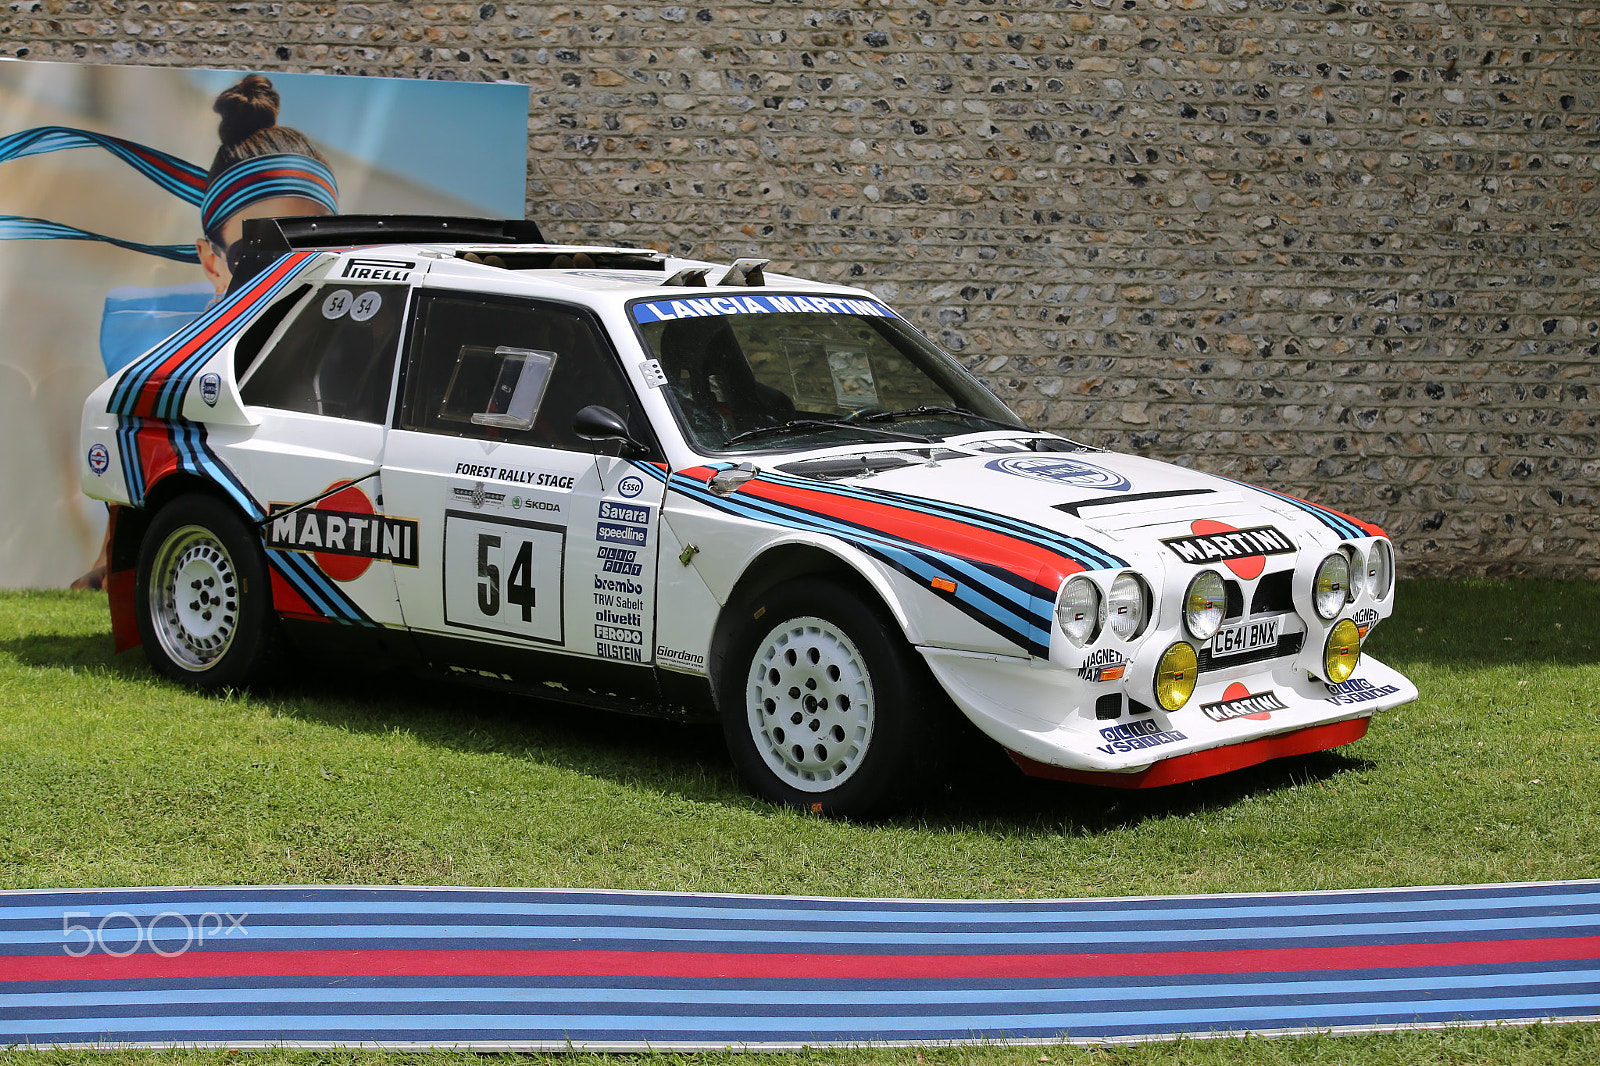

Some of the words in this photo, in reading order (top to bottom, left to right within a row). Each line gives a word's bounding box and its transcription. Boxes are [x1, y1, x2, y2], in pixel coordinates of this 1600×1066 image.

[341, 258, 416, 281] PIRELLI
[329, 297, 346, 312] 54
[357, 299, 374, 314] 54
[646, 296, 770, 321] LANCIA
[765, 297, 885, 317] MARTINI
[455, 462, 497, 479] FOREST
[498, 468, 535, 484] RALLY
[536, 473, 575, 489] STAGE
[525, 498, 561, 512] ŠKODA
[601, 502, 647, 523] Savara
[272, 511, 411, 560] MARTINI
[599, 526, 645, 541] speedline
[599, 548, 635, 561] OLIO
[1170, 529, 1290, 562] MARTINI
[477, 533, 536, 623] 54
[604, 561, 641, 575] FIAT
[594, 574, 643, 595] brembo
[593, 593, 614, 606] TRW
[616, 596, 644, 611] Sabelt
[595, 609, 641, 627] olivetti
[596, 625, 641, 644] FERODO
[1215, 626, 1247, 652] C641
[1250, 621, 1277, 646] BNX
[597, 642, 642, 662] BILSTEIN
[656, 645, 704, 664] Giordano
[1204, 694, 1283, 720] MARTINI
[1100, 719, 1162, 742] OLIO
